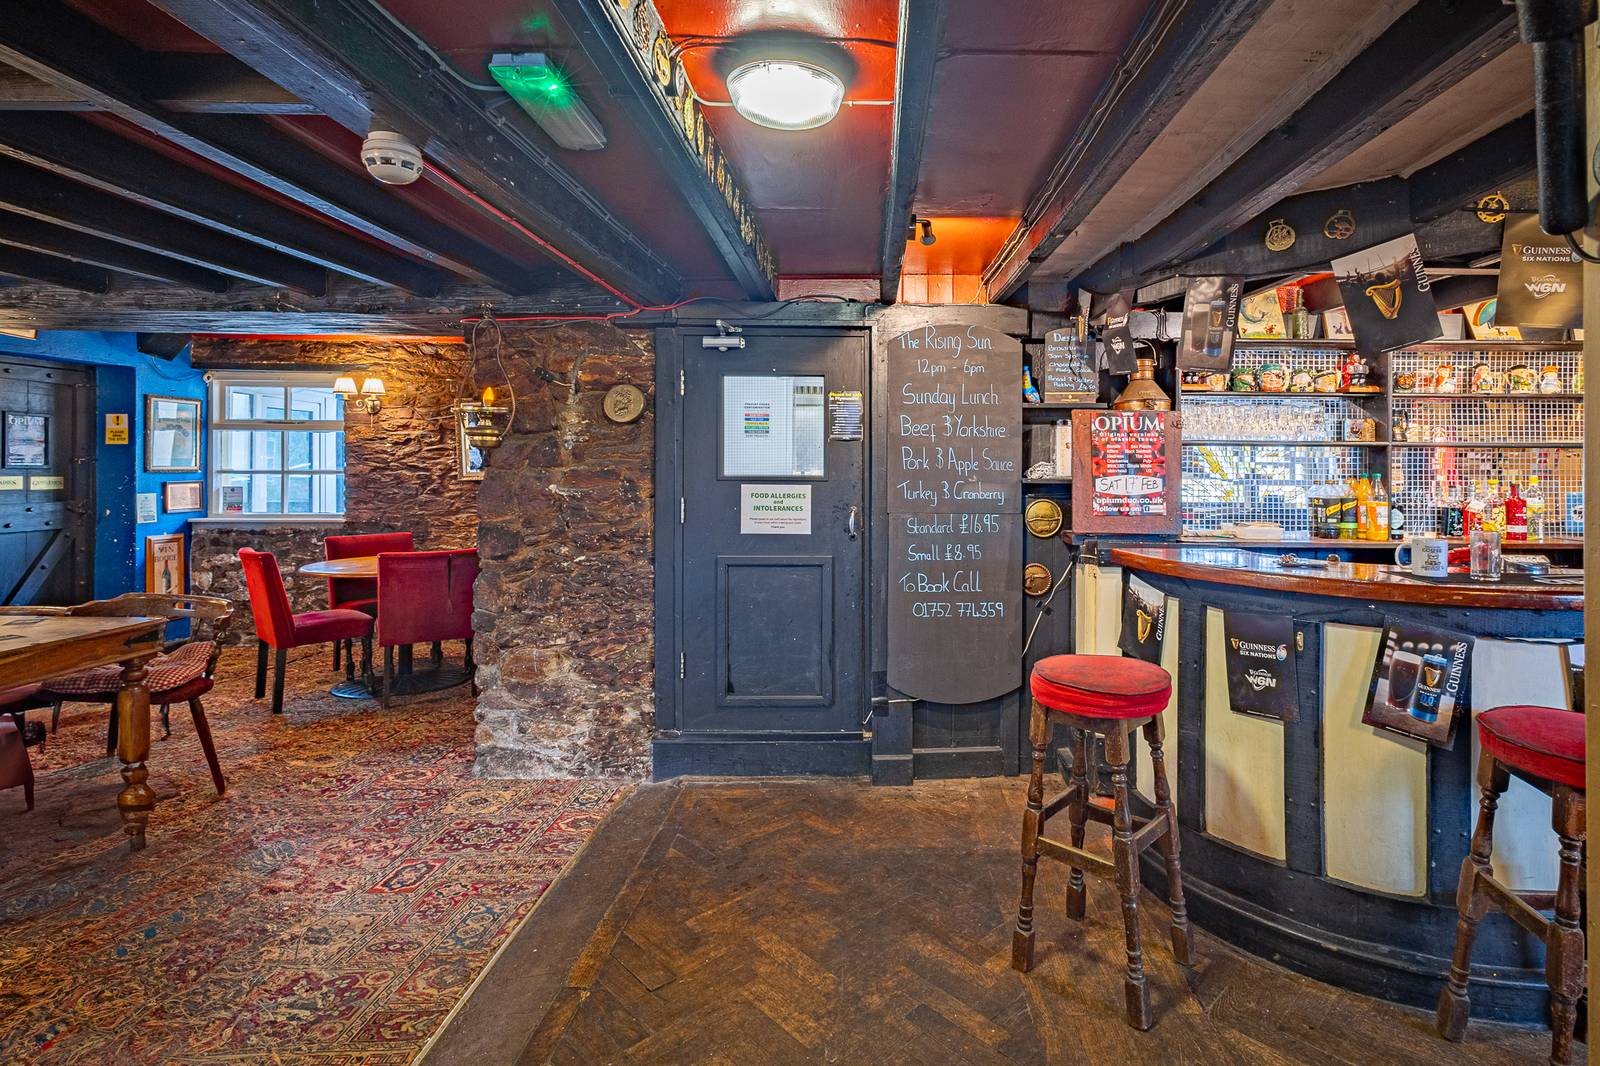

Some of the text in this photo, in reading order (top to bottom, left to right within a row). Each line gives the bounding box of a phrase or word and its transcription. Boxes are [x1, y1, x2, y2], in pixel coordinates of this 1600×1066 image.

[1523, 245, 1571, 254] GUINNESS
[1226, 283, 1239, 327] GUINNESS
[897, 325, 992, 358] The Rising Sun
[917, 359, 946, 376] 12pm
[963, 359, 985, 376] 6pm
[902, 383, 999, 413] Sunday Lunch
[900, 415, 936, 443] Beef
[954, 415, 1006, 438] Yorkshire
[1095, 416, 1160, 431] OPIUM
[901, 446, 929, 470] Pork
[948, 447, 979, 476] Apple
[982, 447, 1014, 471] Sauce
[897, 480, 937, 506] Turkey
[953, 480, 1005, 505] Cranberry
[1100, 478, 1122, 491] SAT
[1141, 477, 1159, 491] FEB
[1096, 496, 1163, 505] opiumduo.co.uk
[907, 513, 999, 534] Standard £16.95
[907, 543, 982, 561] Small £8.95
[899, 570, 982, 592] To Book Call
[912, 602, 952, 617] 01752
[1240, 641, 1276, 652] GUINNESS
[1446, 642, 1468, 693] GUINNESS
